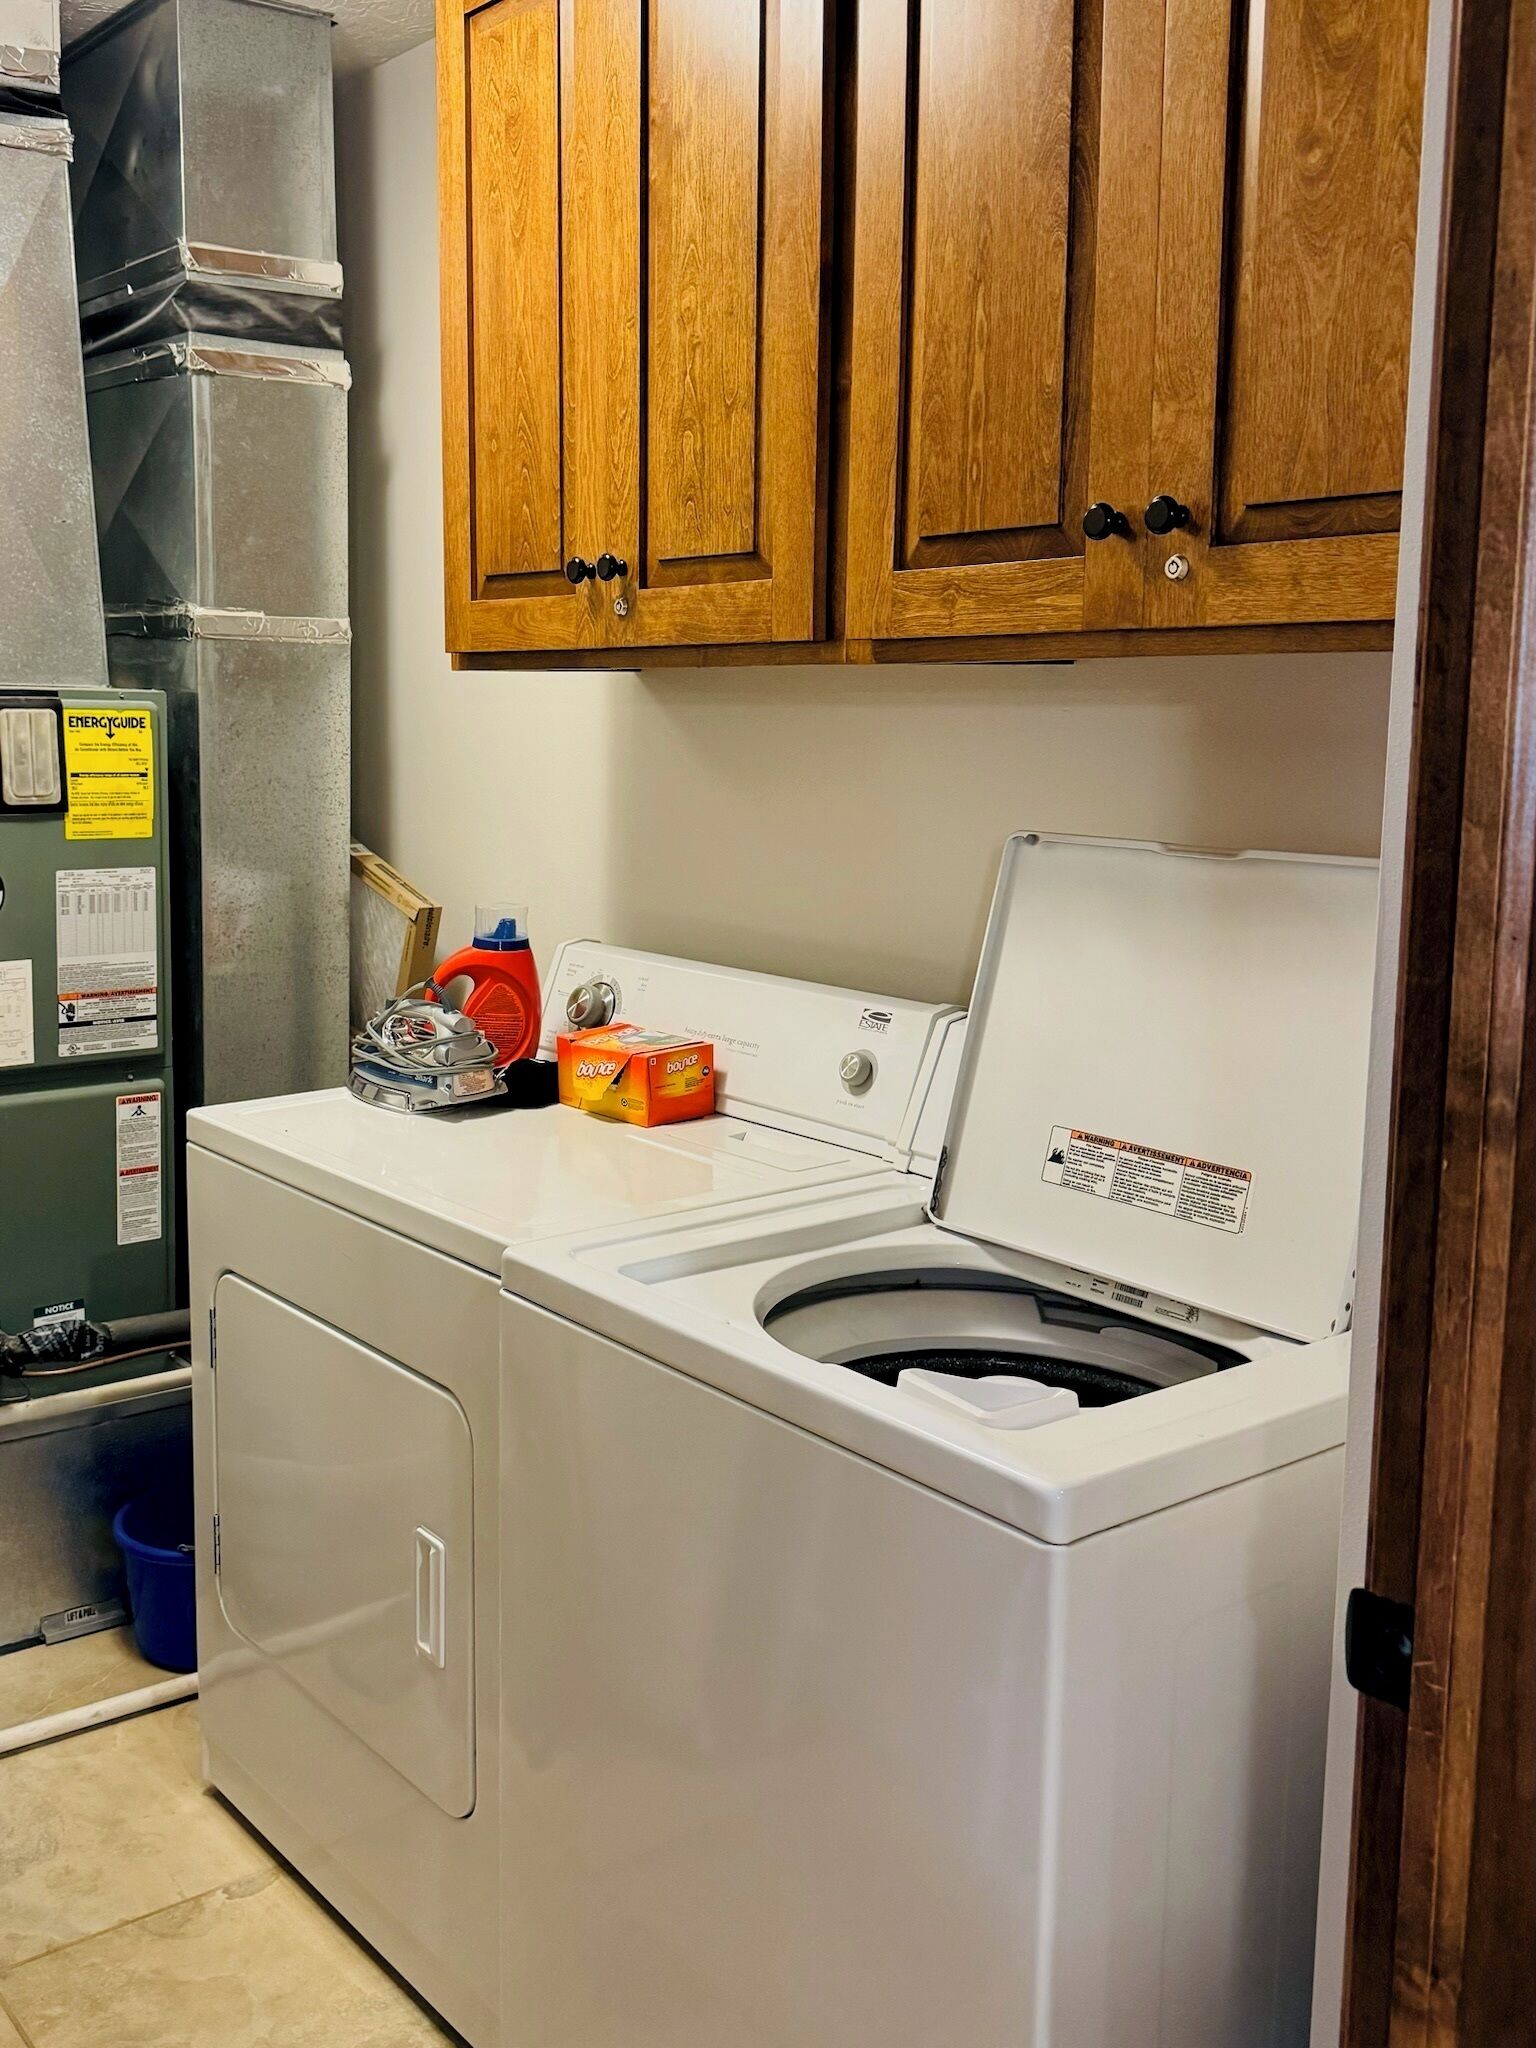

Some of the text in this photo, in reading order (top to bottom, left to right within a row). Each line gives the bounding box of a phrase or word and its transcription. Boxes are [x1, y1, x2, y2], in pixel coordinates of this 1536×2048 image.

[68, 716, 146, 728] ENERGYGUIDE
[859, 1020, 888, 1032] ESTATE
[721, 1034, 737, 1046] large
[737, 1040, 760, 1051] capacity
[576, 1060, 617, 1078] bounce
[666, 1053, 699, 1075] bounce
[1084, 1134, 1115, 1147] WARNING
[1128, 1145, 1184, 1164] AVERTISSEMENT
[1197, 1161, 1247, 1179] ADVERTENCIA
[45, 1302, 74, 1315] NOTICE
